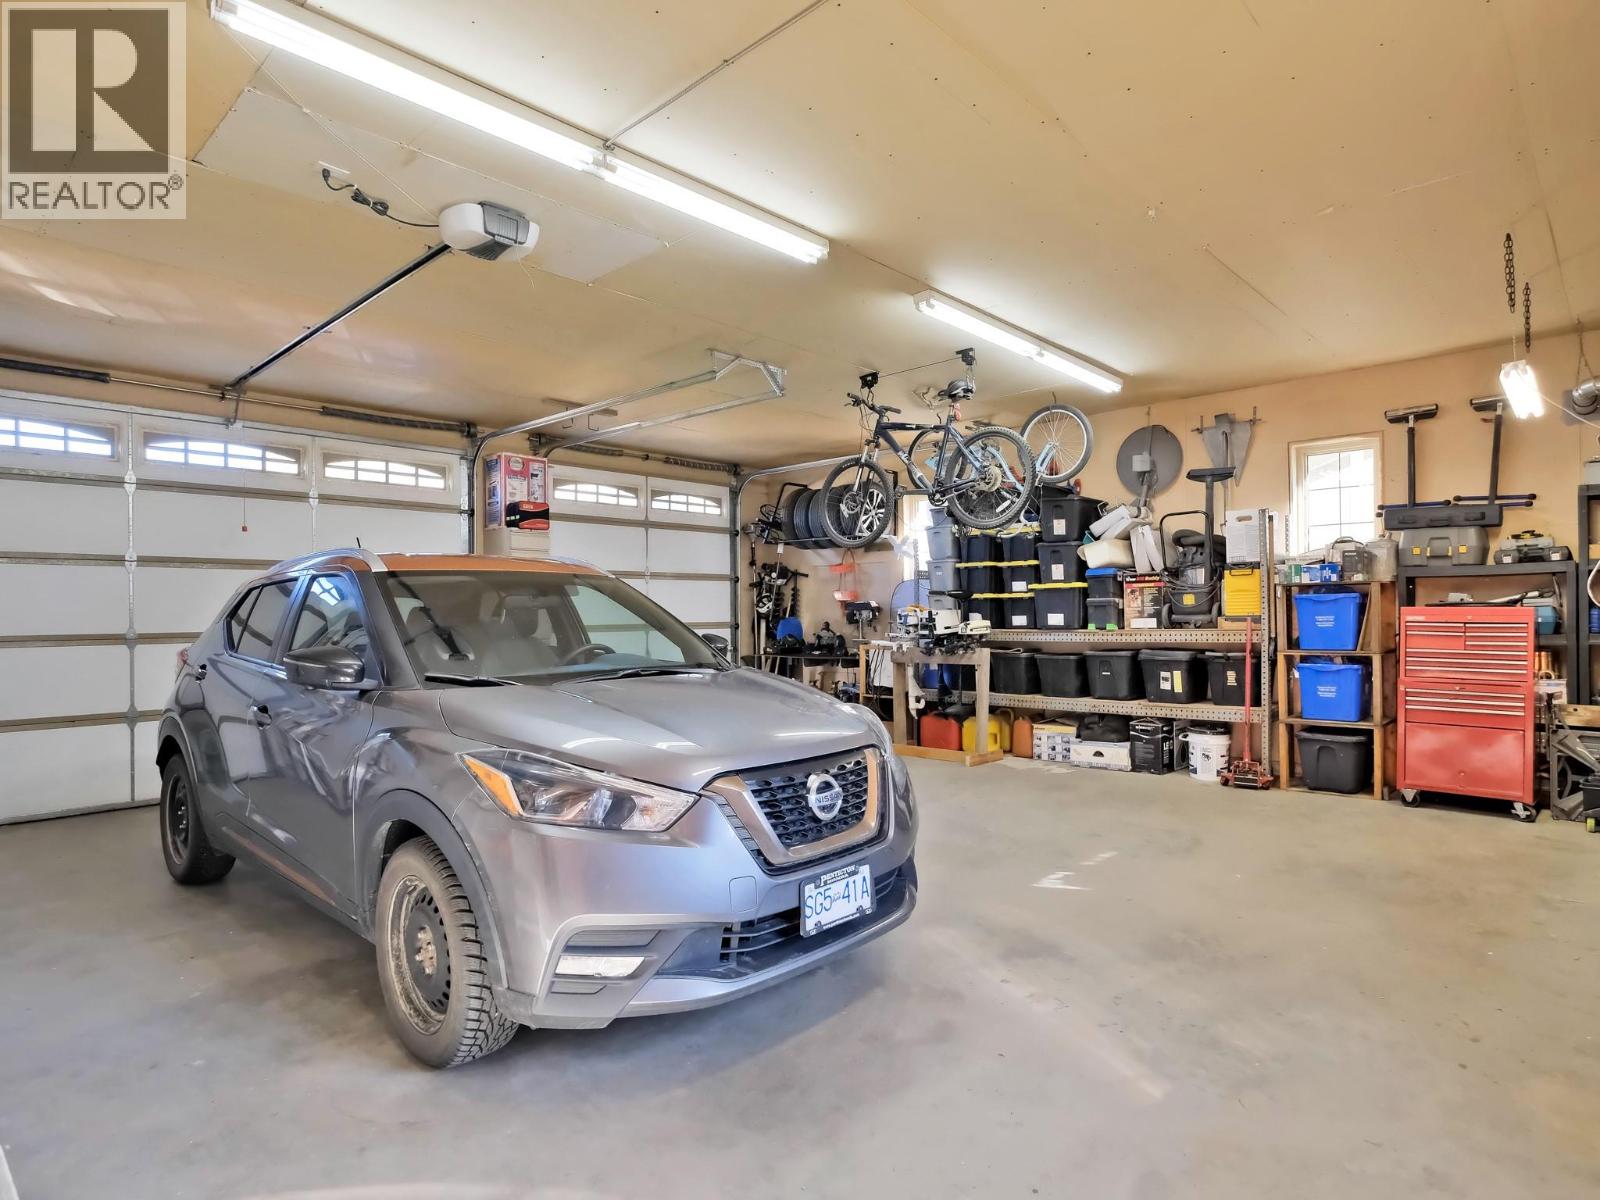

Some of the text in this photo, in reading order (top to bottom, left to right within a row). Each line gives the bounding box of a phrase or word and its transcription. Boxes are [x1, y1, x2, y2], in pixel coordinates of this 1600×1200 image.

[815, 791, 842, 804] NISSAN
[804, 875, 870, 920] SG5 41A
